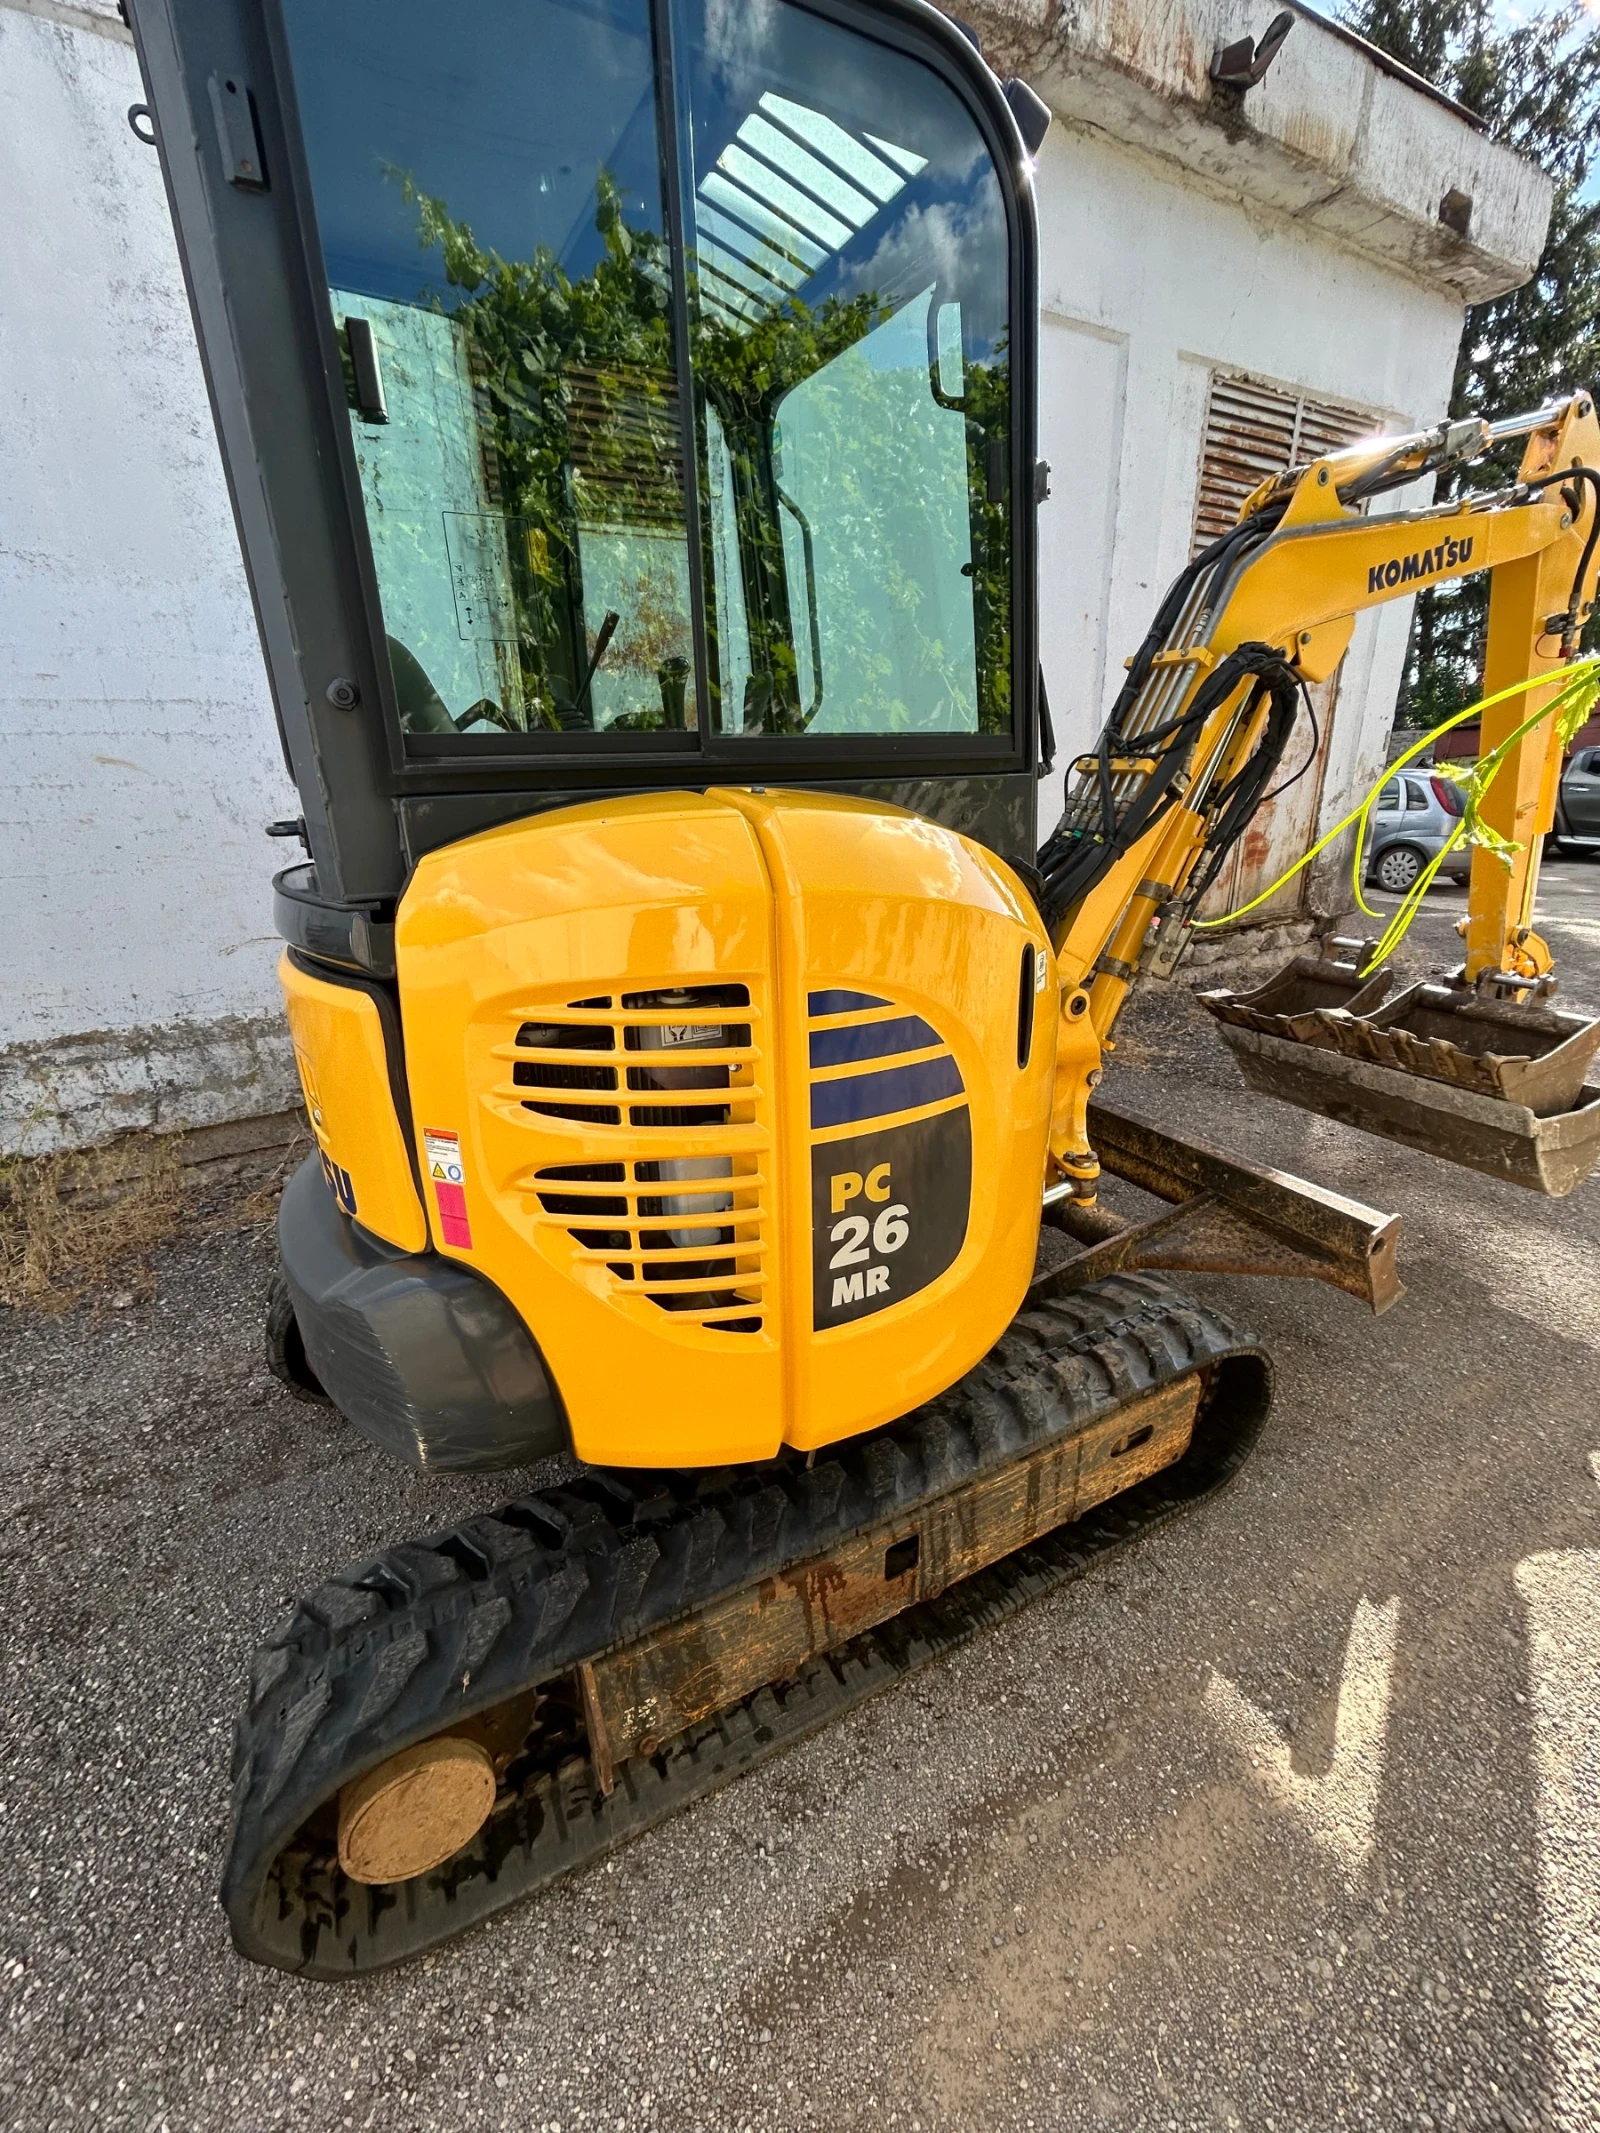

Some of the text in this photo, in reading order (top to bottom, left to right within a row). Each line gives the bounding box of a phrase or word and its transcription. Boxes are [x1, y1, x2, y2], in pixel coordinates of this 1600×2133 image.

[1368, 535, 1474, 594] KOMATSU
[830, 1162, 891, 1214] PC
[829, 1203, 910, 1269] 26
[831, 1265, 891, 1307] MR
